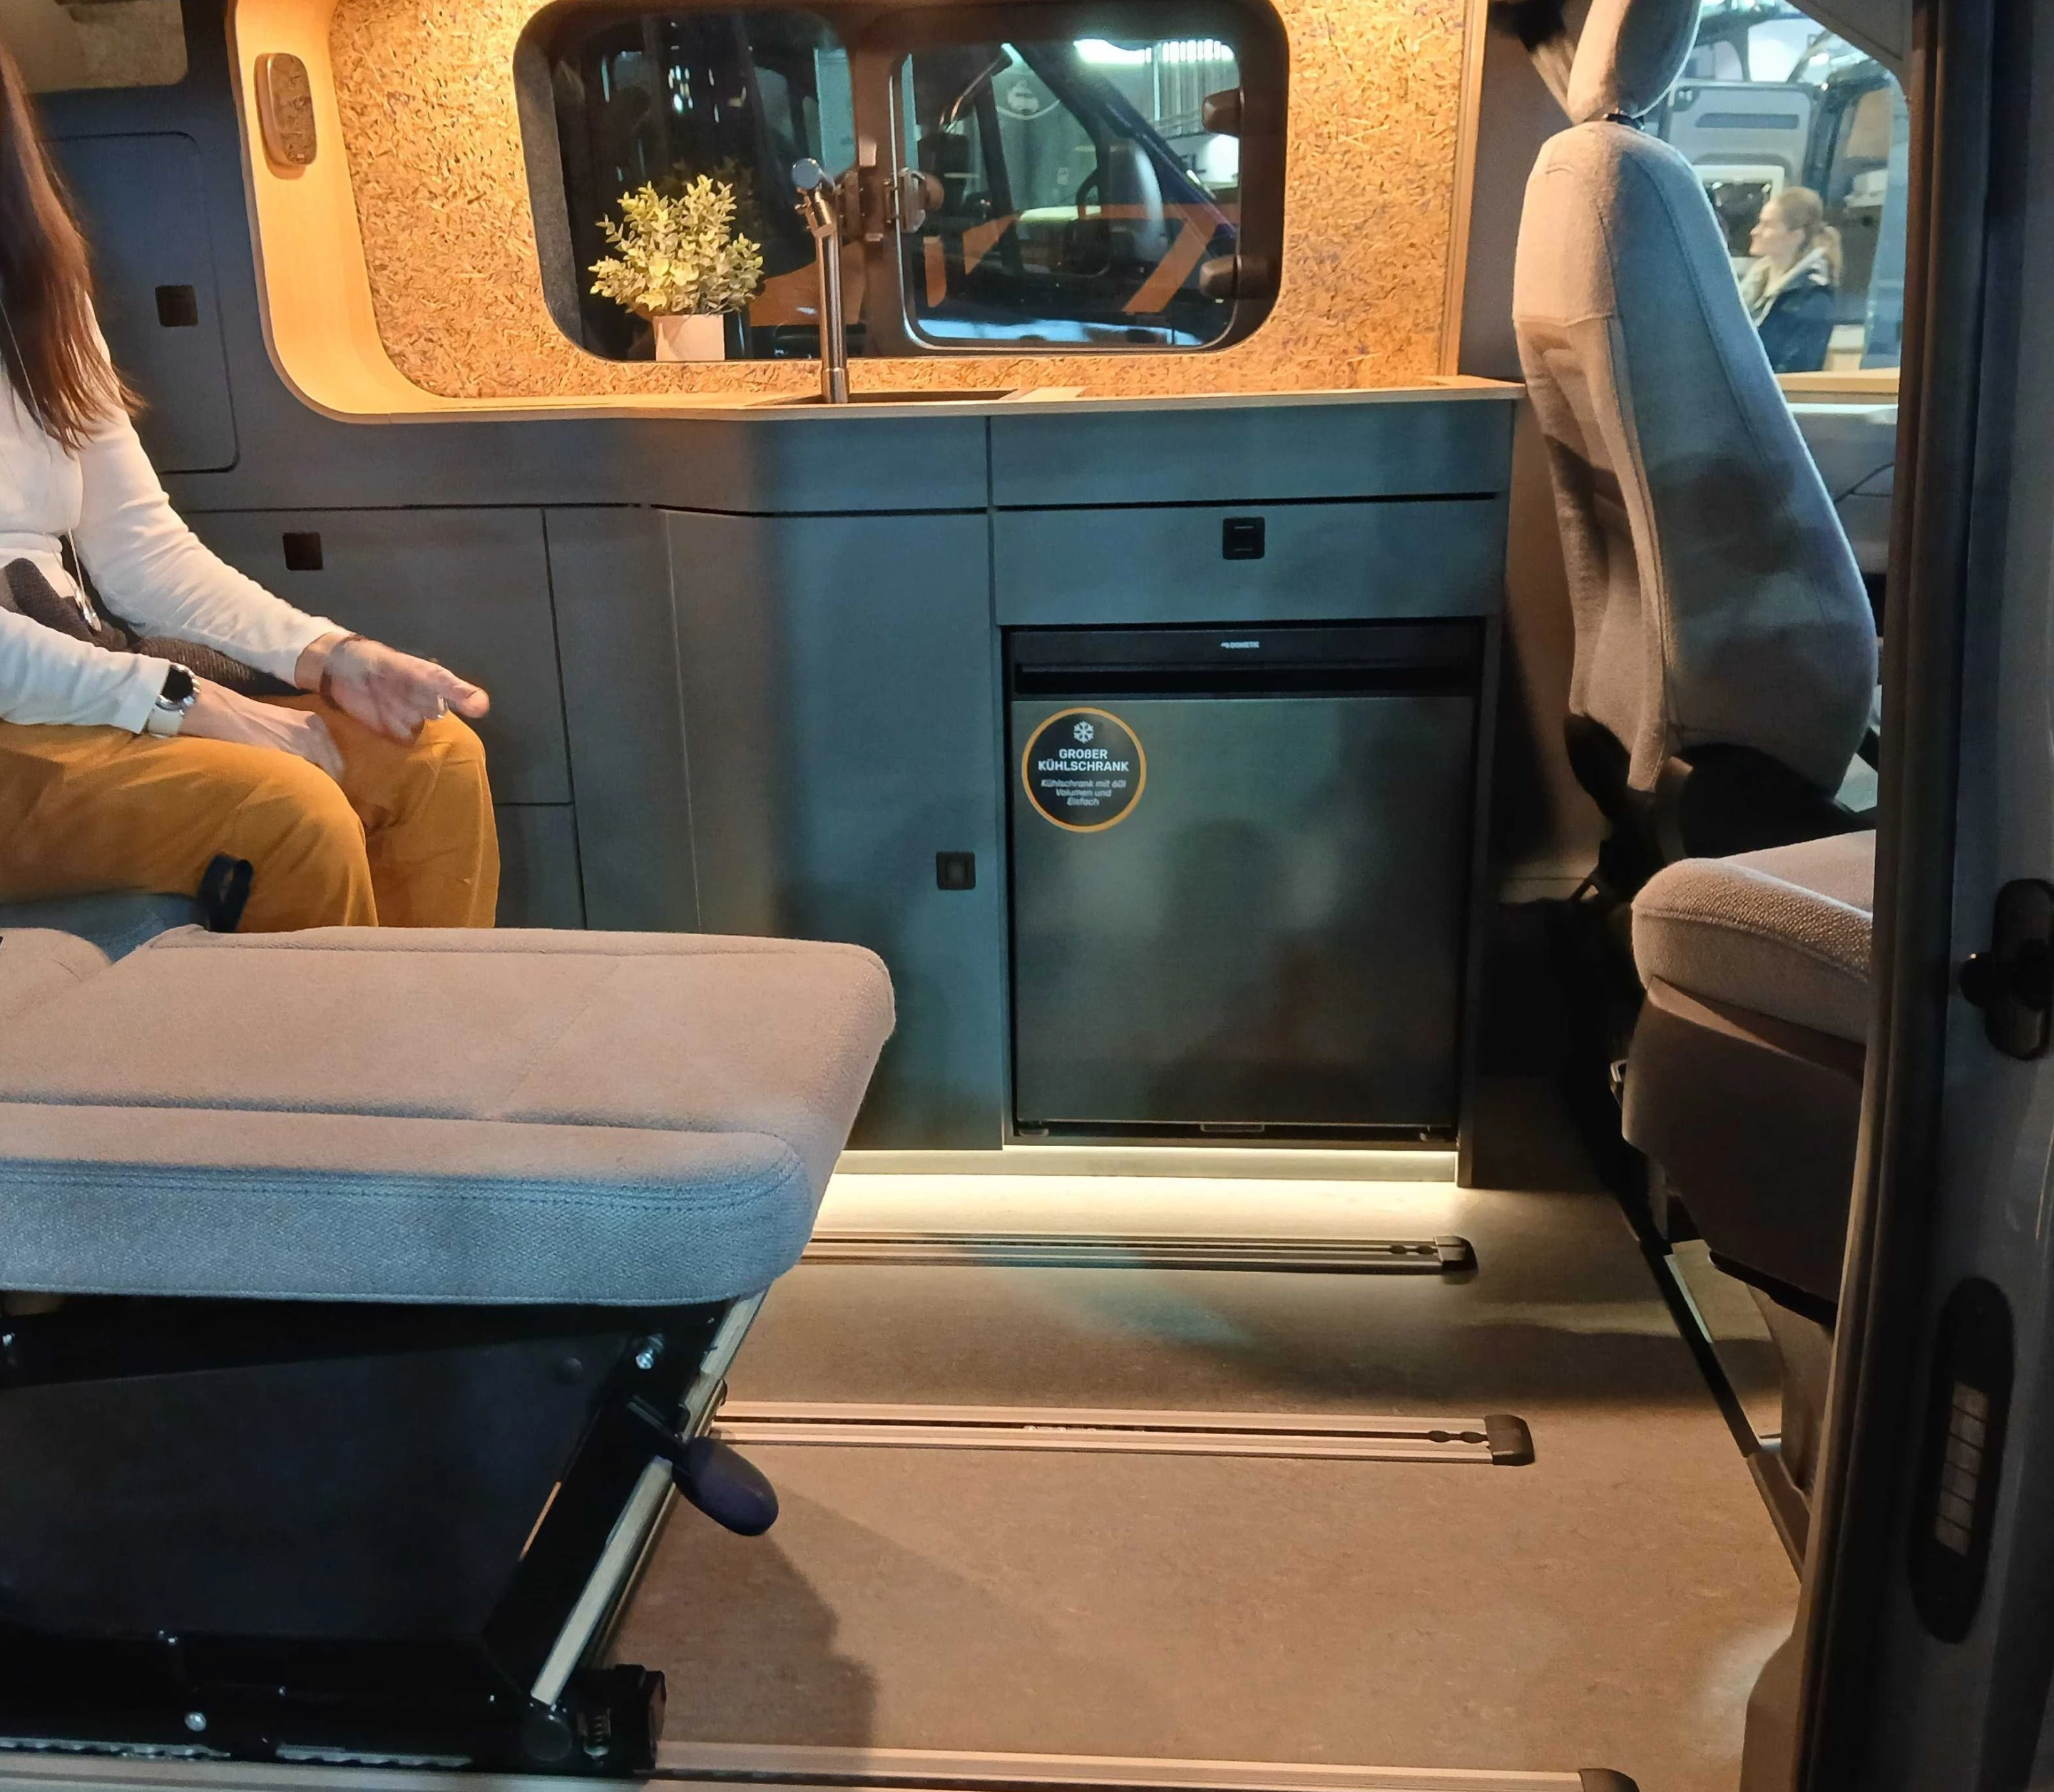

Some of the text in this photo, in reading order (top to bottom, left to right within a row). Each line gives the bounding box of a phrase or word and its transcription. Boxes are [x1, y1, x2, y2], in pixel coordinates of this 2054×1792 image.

[1038, 759, 1129, 772] KÜHLSCHRANK
[1041, 779, 1093, 788] Kühlschrank
[1095, 779, 1110, 788] mit
[1056, 788, 1113, 797] Volumen und
[1066, 797, 1100, 806] Eisfach
